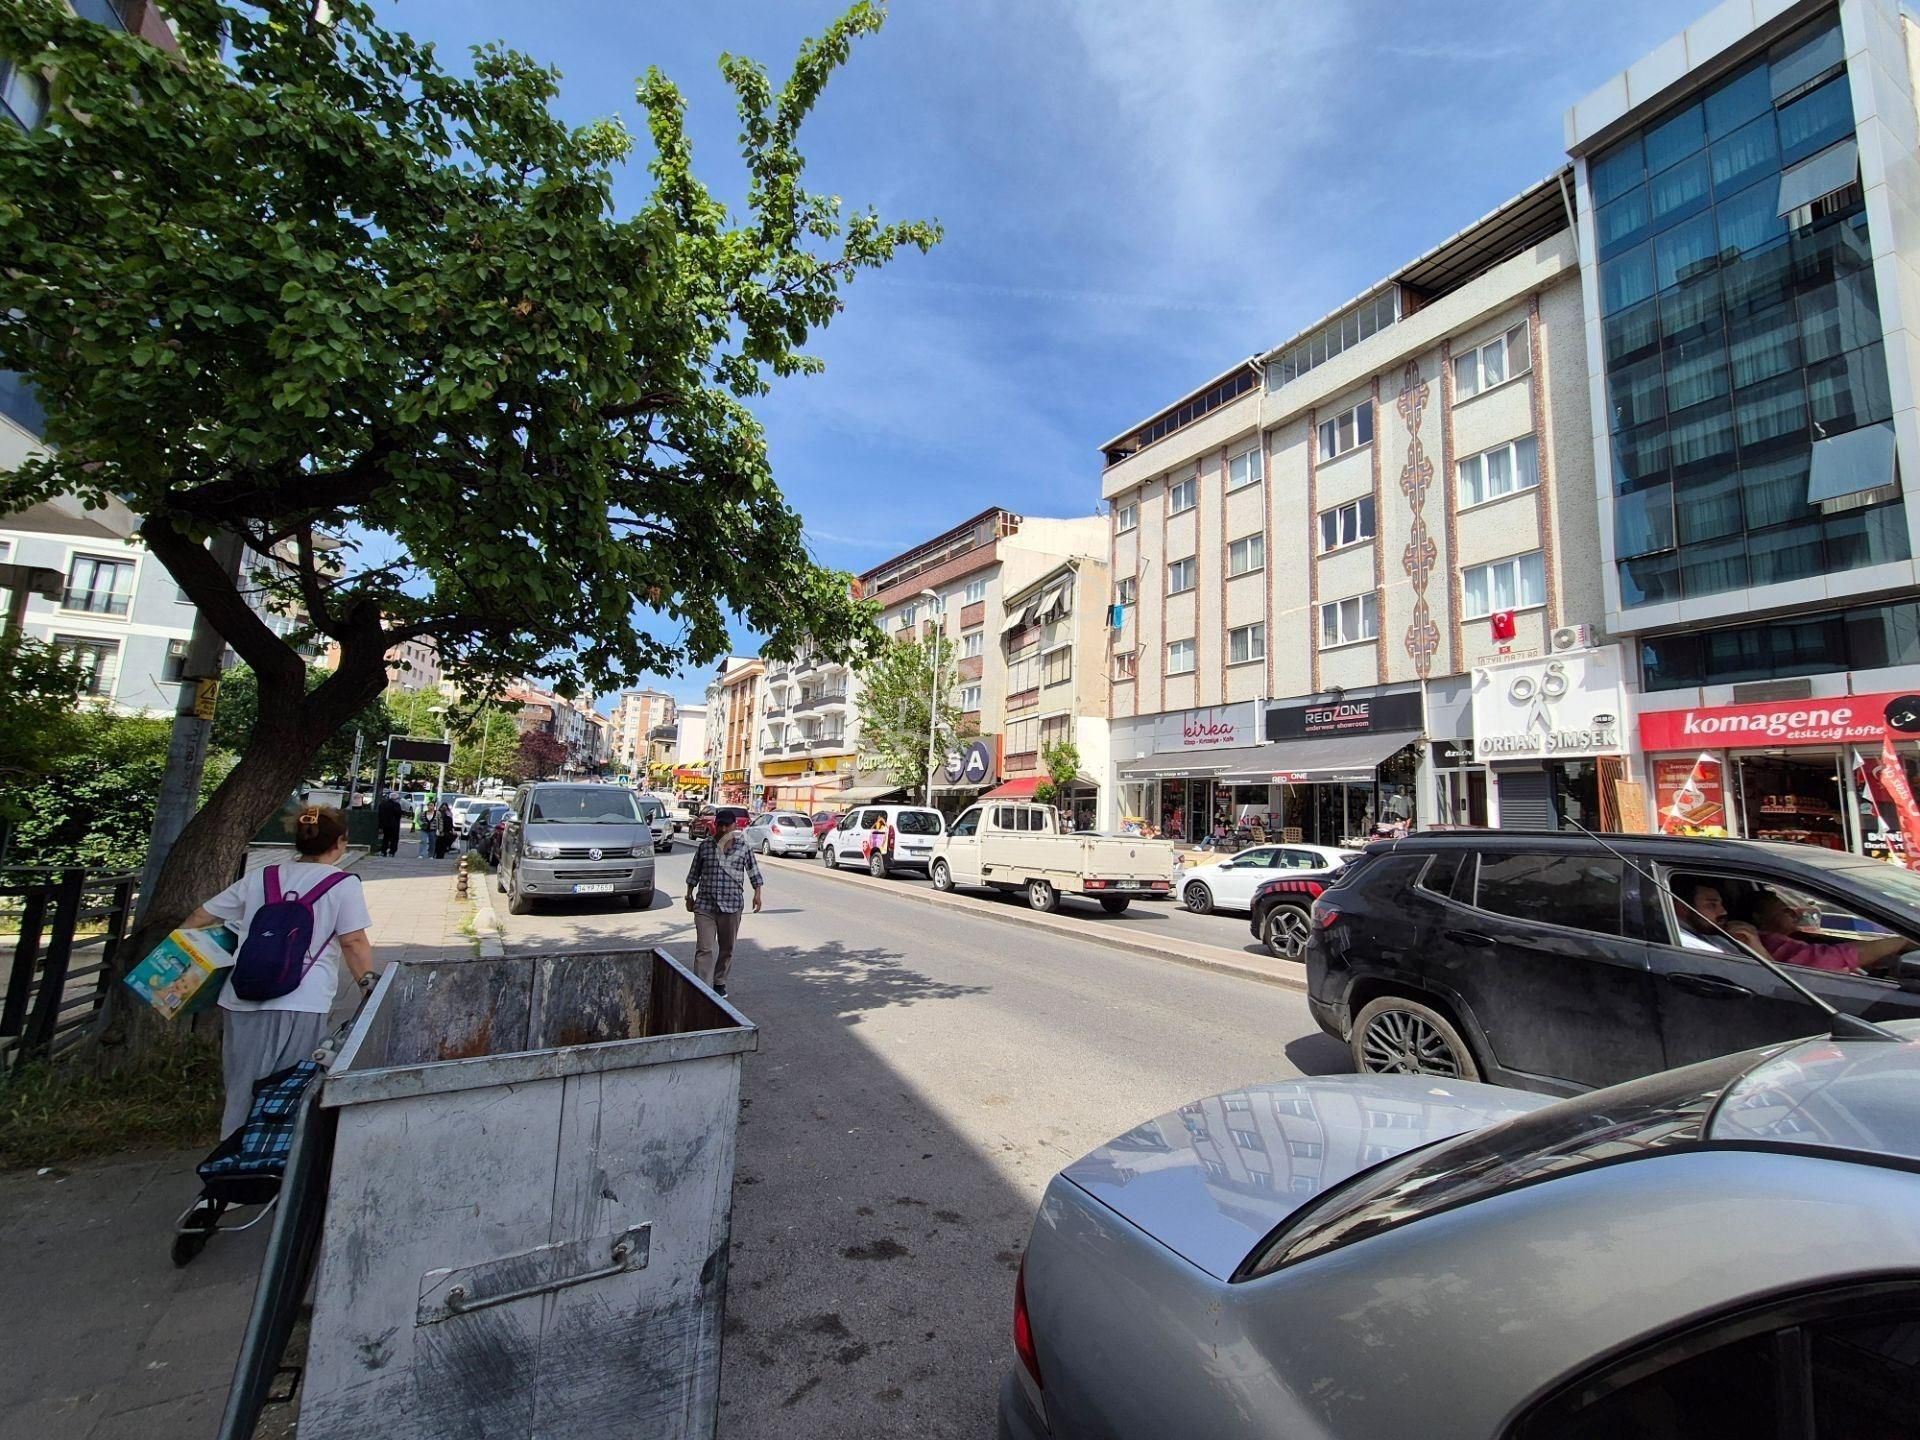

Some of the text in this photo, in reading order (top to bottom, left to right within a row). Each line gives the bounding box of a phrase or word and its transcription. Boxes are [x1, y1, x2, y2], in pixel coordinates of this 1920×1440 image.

[1184, 709, 1234, 738] kirka
[1337, 721, 1369, 729] showroom
[1684, 707, 1853, 736] komagene
[1787, 729, 1820, 739] etsiz
[1845, 725, 1885, 737] köfte
[1479, 735, 1541, 752] ORHAN
